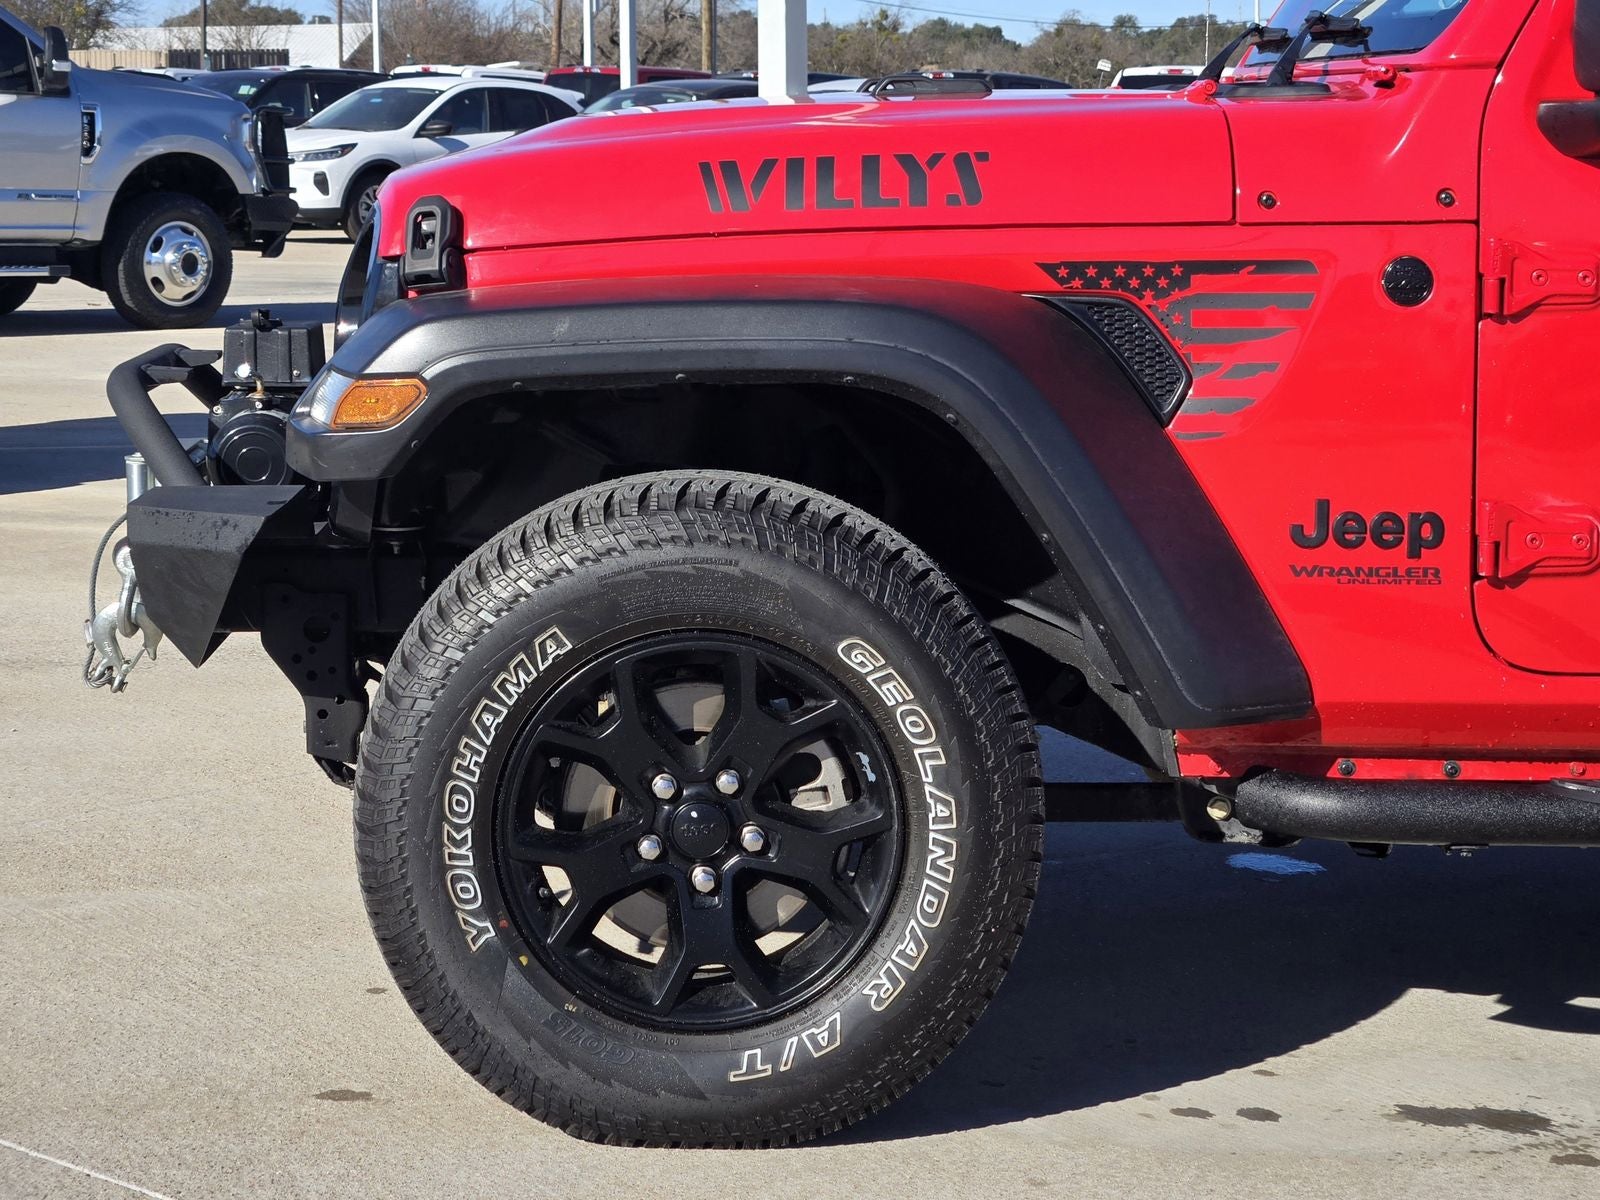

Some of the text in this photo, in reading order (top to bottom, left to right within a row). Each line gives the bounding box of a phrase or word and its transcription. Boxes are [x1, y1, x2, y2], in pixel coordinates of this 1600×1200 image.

[698, 151, 990, 213] WILLYS
[1289, 498, 1445, 559] Jeep
[1288, 564, 1441, 579] WRANGLER
[1336, 578, 1442, 586] UNLIMITED
[442, 624, 573, 953] YOKOHAMA
[837, 637, 958, 1012] GEOLANDAR
[729, 1011, 841, 1083] A/T
